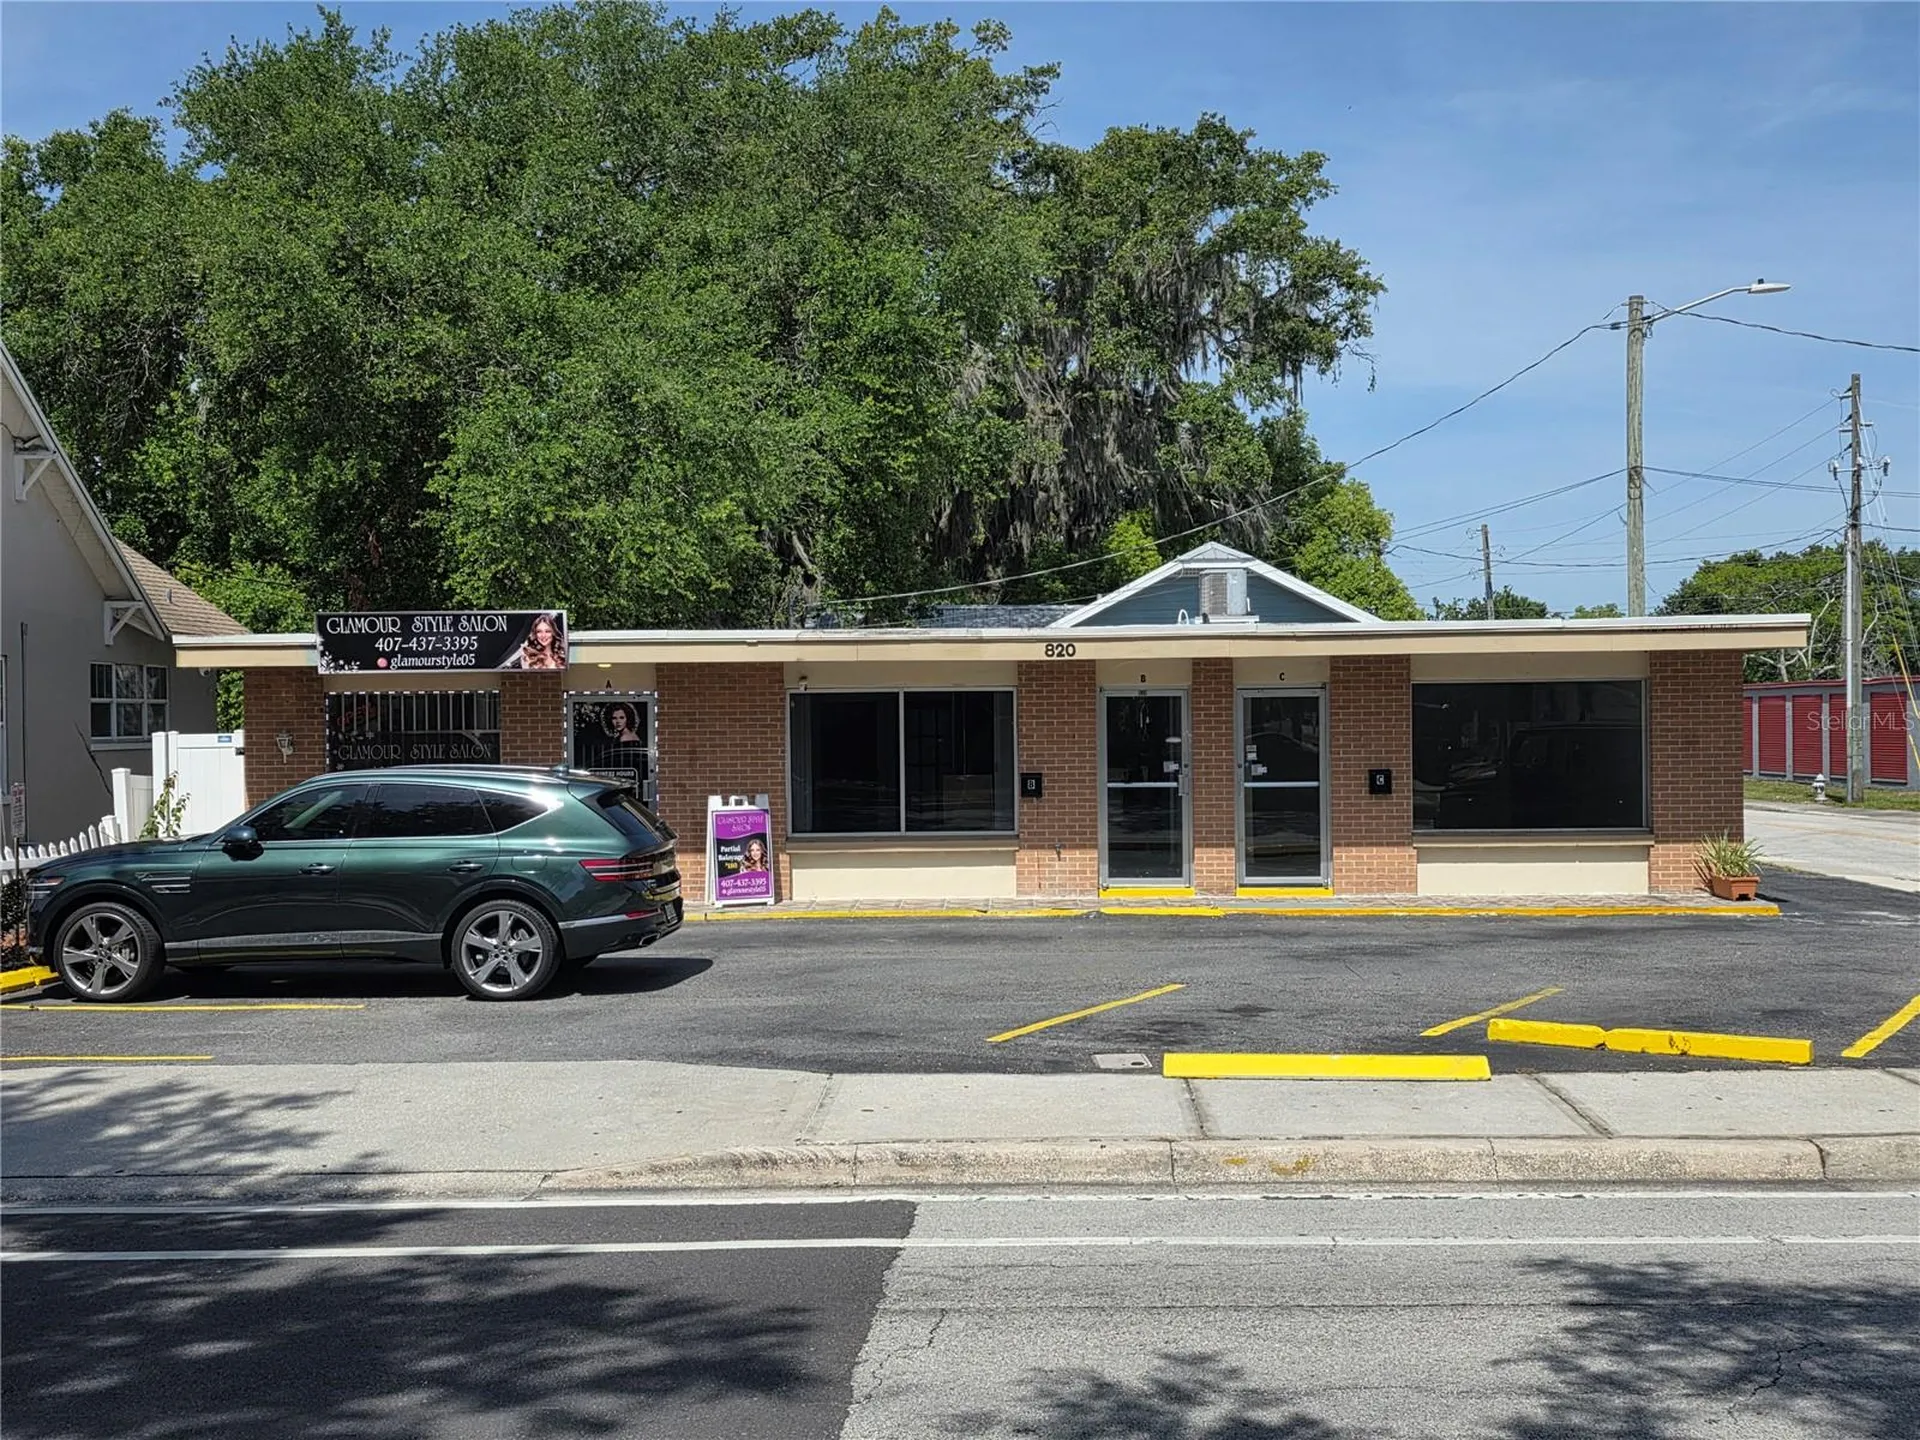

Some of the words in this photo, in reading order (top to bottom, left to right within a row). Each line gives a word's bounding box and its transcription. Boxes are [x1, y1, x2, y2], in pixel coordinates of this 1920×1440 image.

[326, 617, 401, 634] GLAMOUR
[411, 616, 454, 633] STYLE
[458, 615, 508, 633] SALON
[374, 636, 478, 652] 407-437-3395
[1044, 643, 1077, 658] 820
[389, 653, 476, 670] glamourstyle05
[605, 679, 612, 689] A
[1279, 672, 1285, 681] C
[337, 744, 401, 761] GLAMOUR
[410, 744, 446, 760] STYLE
[450, 743, 492, 760] SALON
